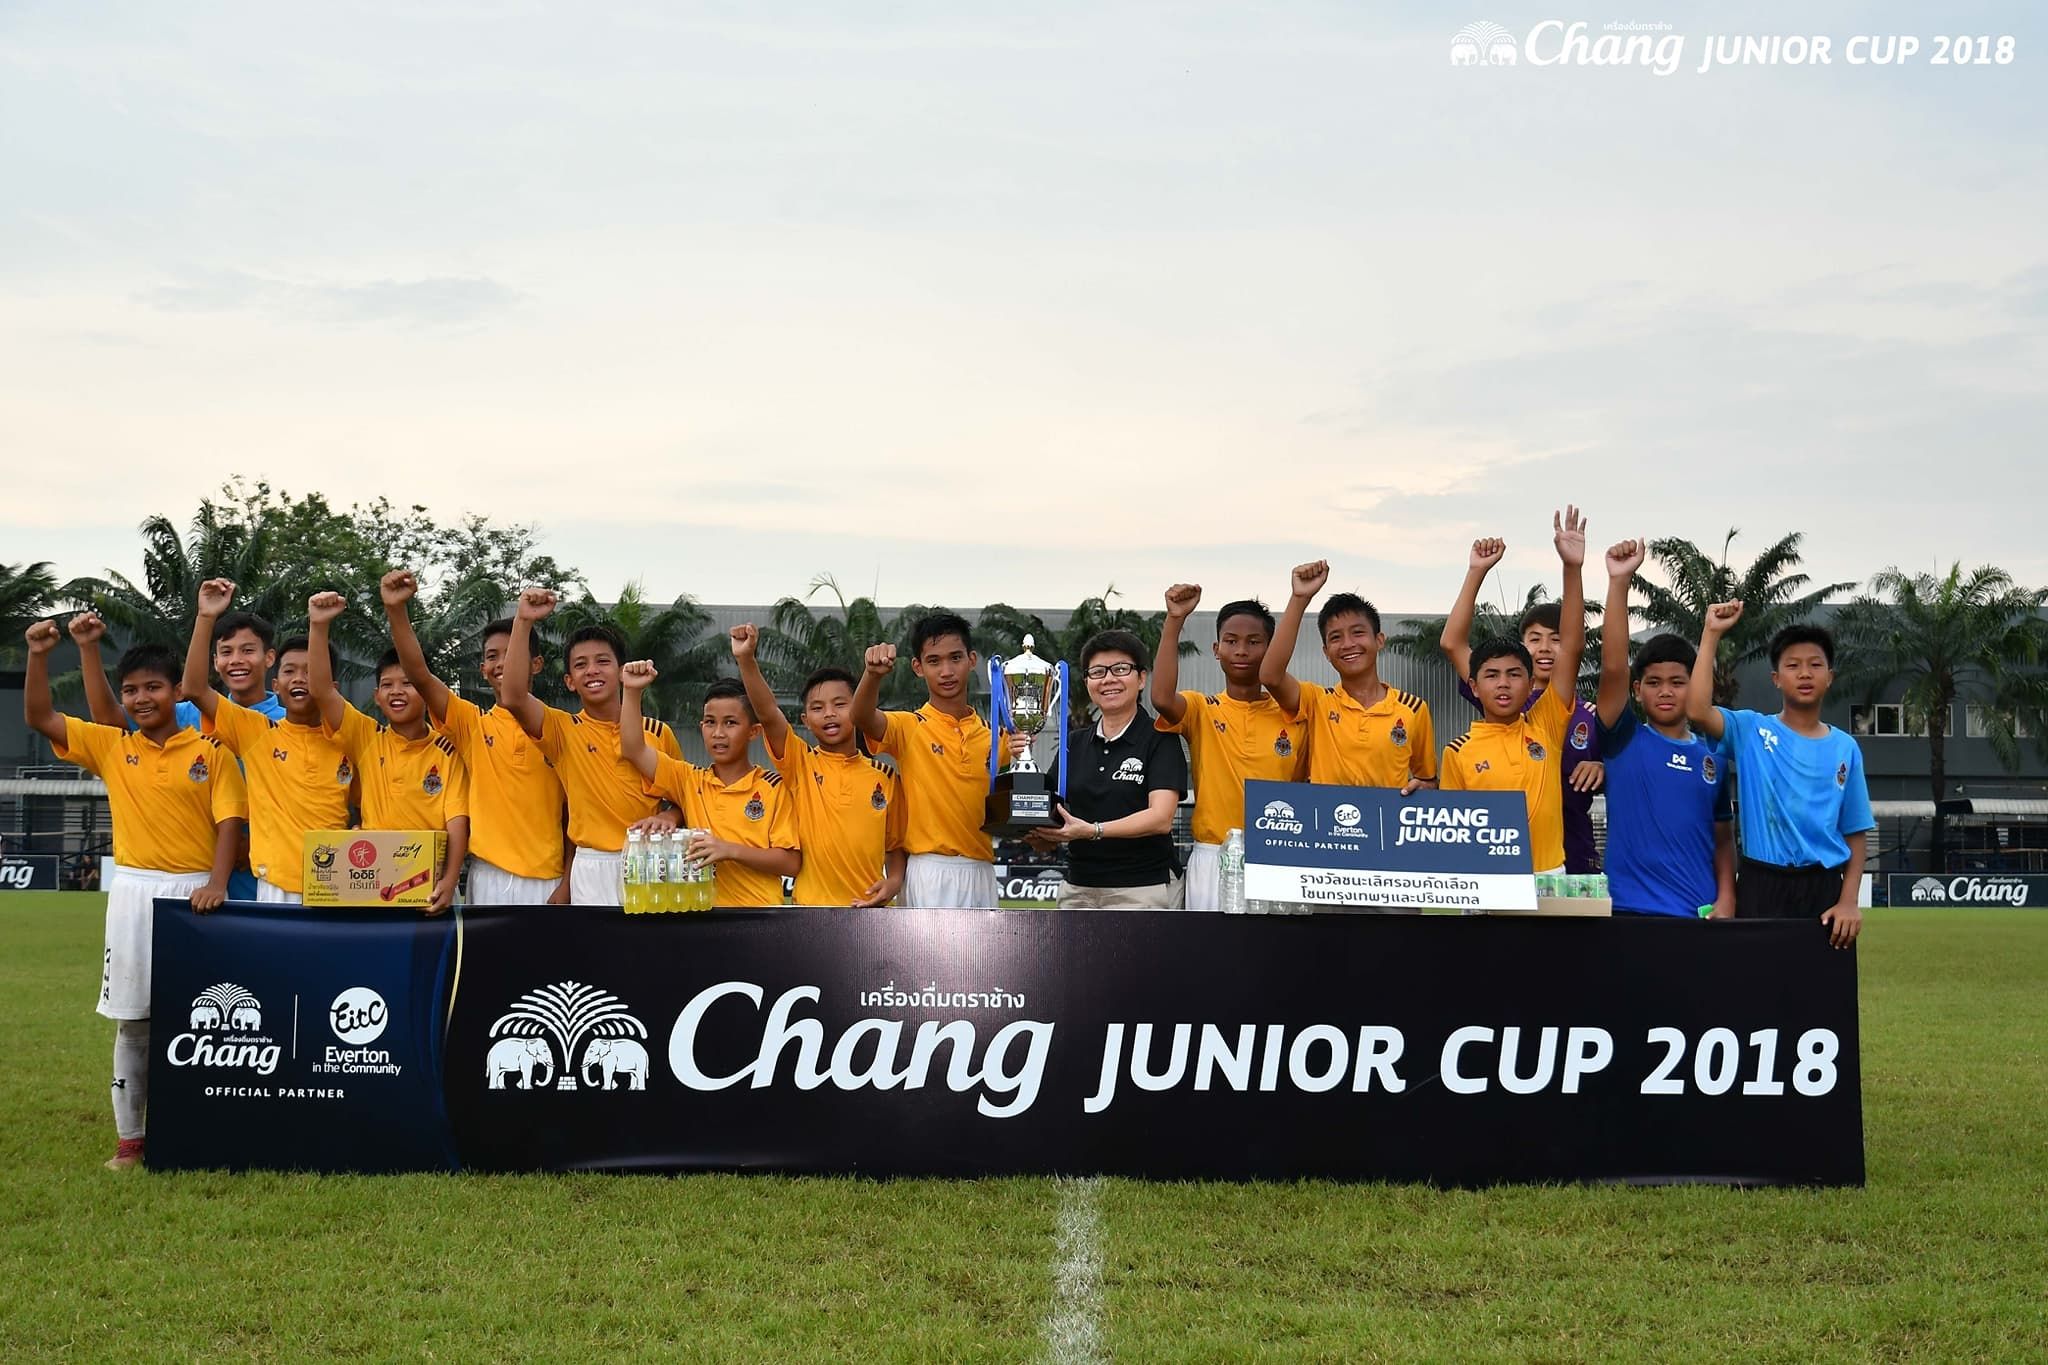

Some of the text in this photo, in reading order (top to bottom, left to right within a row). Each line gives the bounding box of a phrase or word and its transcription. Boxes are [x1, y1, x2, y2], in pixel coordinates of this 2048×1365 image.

[1111, 769, 1145, 785] Chang
[1255, 817, 1303, 834] Chang
[1399, 806, 1488, 827] CHANG
[1334, 825, 1363, 834] Everton
[1395, 826, 1519, 846] JUNIOR CUP
[1265, 839, 1360, 851] OFFICIAL PARTNER
[1488, 846, 1520, 855] 2018
[1006, 878, 1058, 899] Chan
[1948, 876, 2028, 906] Chang
[859, 980, 1025, 1009] เครื่องดื่มตราช้าง
[331, 1000, 388, 1034] EitC
[167, 1033, 282, 1075] Chang
[325, 1046, 390, 1063] Everton
[668, 981, 1840, 1118] Chang JUNIOR CUP 2018
[312, 1062, 402, 1077] in the Community
[204, 1086, 345, 1099] OFFICIAL PARTNER
